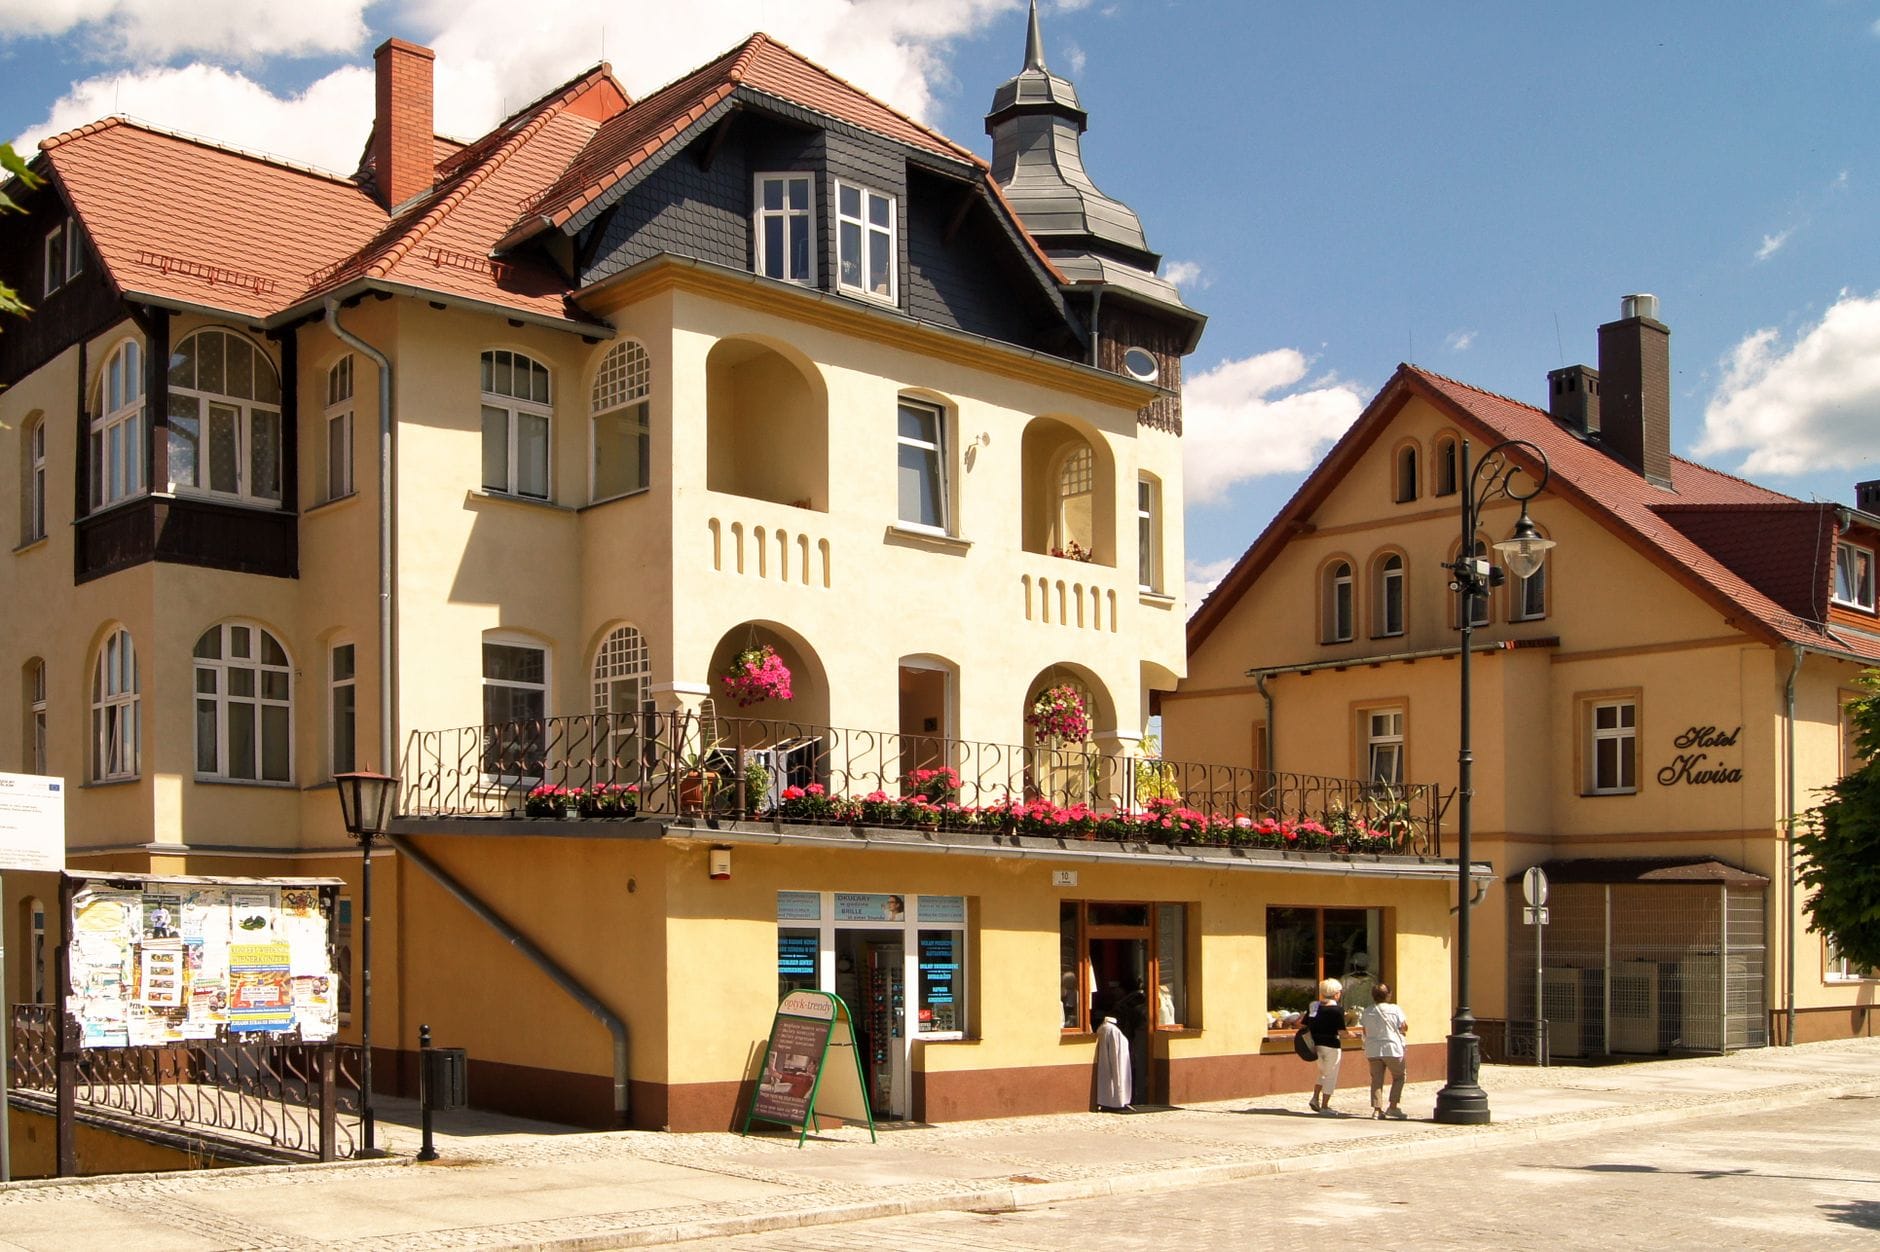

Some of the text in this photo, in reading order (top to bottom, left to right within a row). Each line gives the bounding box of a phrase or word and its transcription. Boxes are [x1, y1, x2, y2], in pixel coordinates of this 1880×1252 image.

[1674, 726, 1741, 749] Hotel
[1657, 753, 1743, 786] Kwisa
[784, 998, 832, 1014] optyk-trendy
